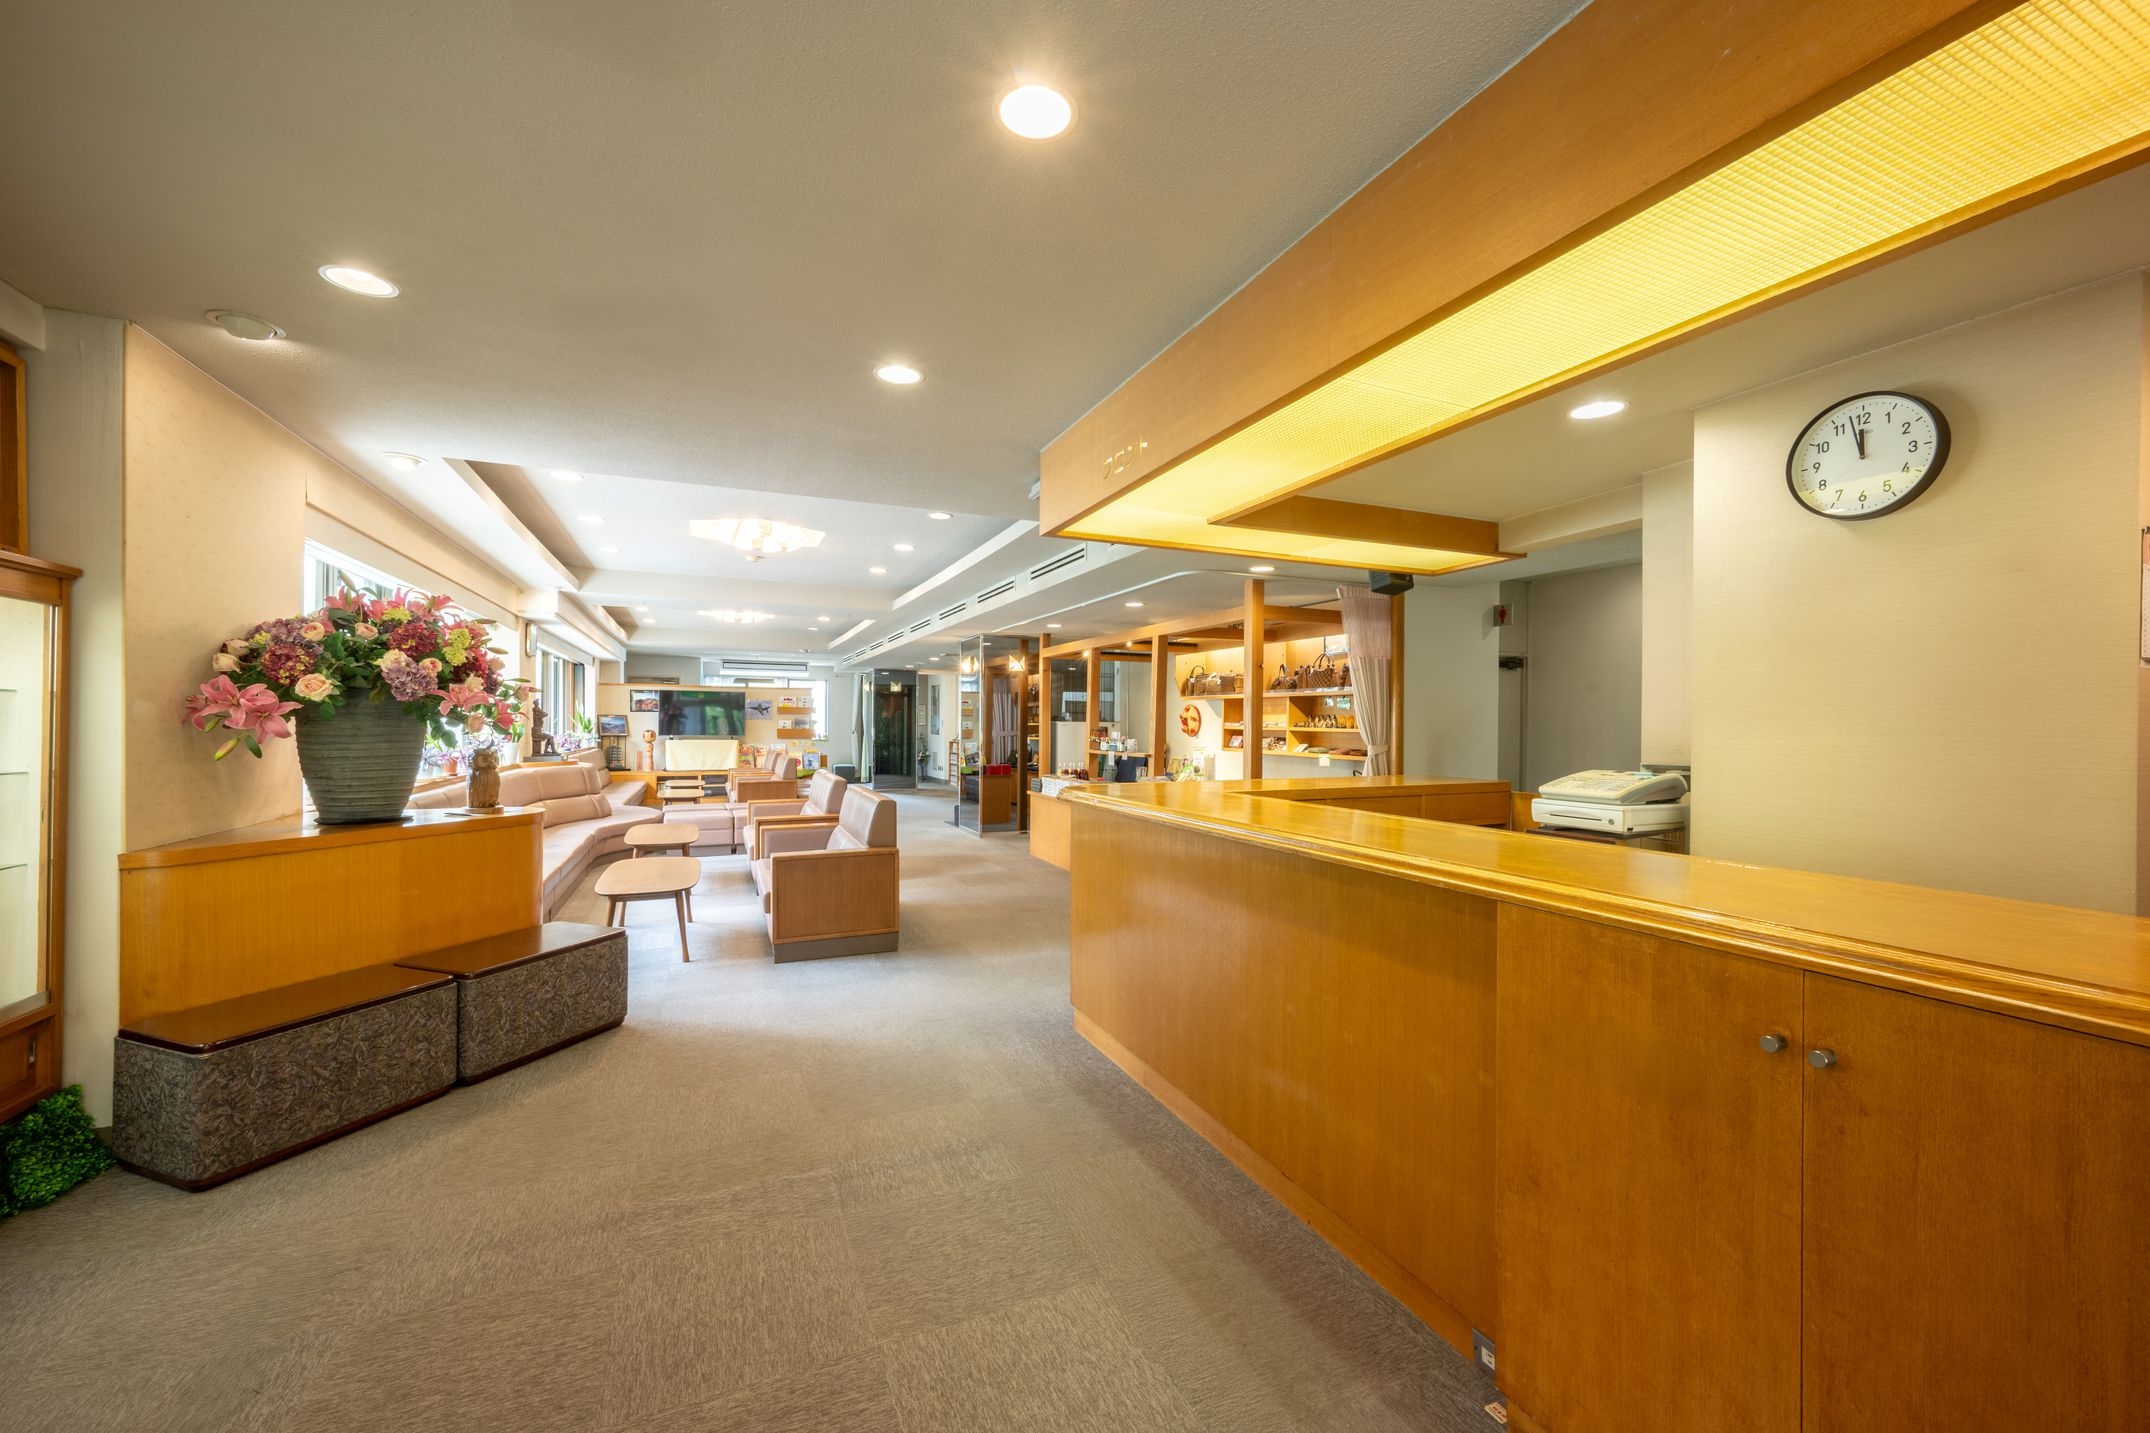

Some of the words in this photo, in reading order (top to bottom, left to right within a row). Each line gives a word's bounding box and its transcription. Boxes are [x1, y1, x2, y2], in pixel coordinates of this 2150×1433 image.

[1856, 411, 1872, 426] 12
[1884, 411, 1892, 424] 1
[1833, 423, 1846, 437] 11
[1901, 421, 1911, 435] 2
[1815, 441, 1830, 454] 10
[1908, 440, 1918, 453] 3
[1812, 462, 1821, 474] 9
[1901, 462, 1911, 474] 4
[1818, 479, 1827, 491] 8
[1882, 479, 1892, 492] 5
[1835, 489, 1844, 503] 7
[1858, 490, 1867, 502] 6
